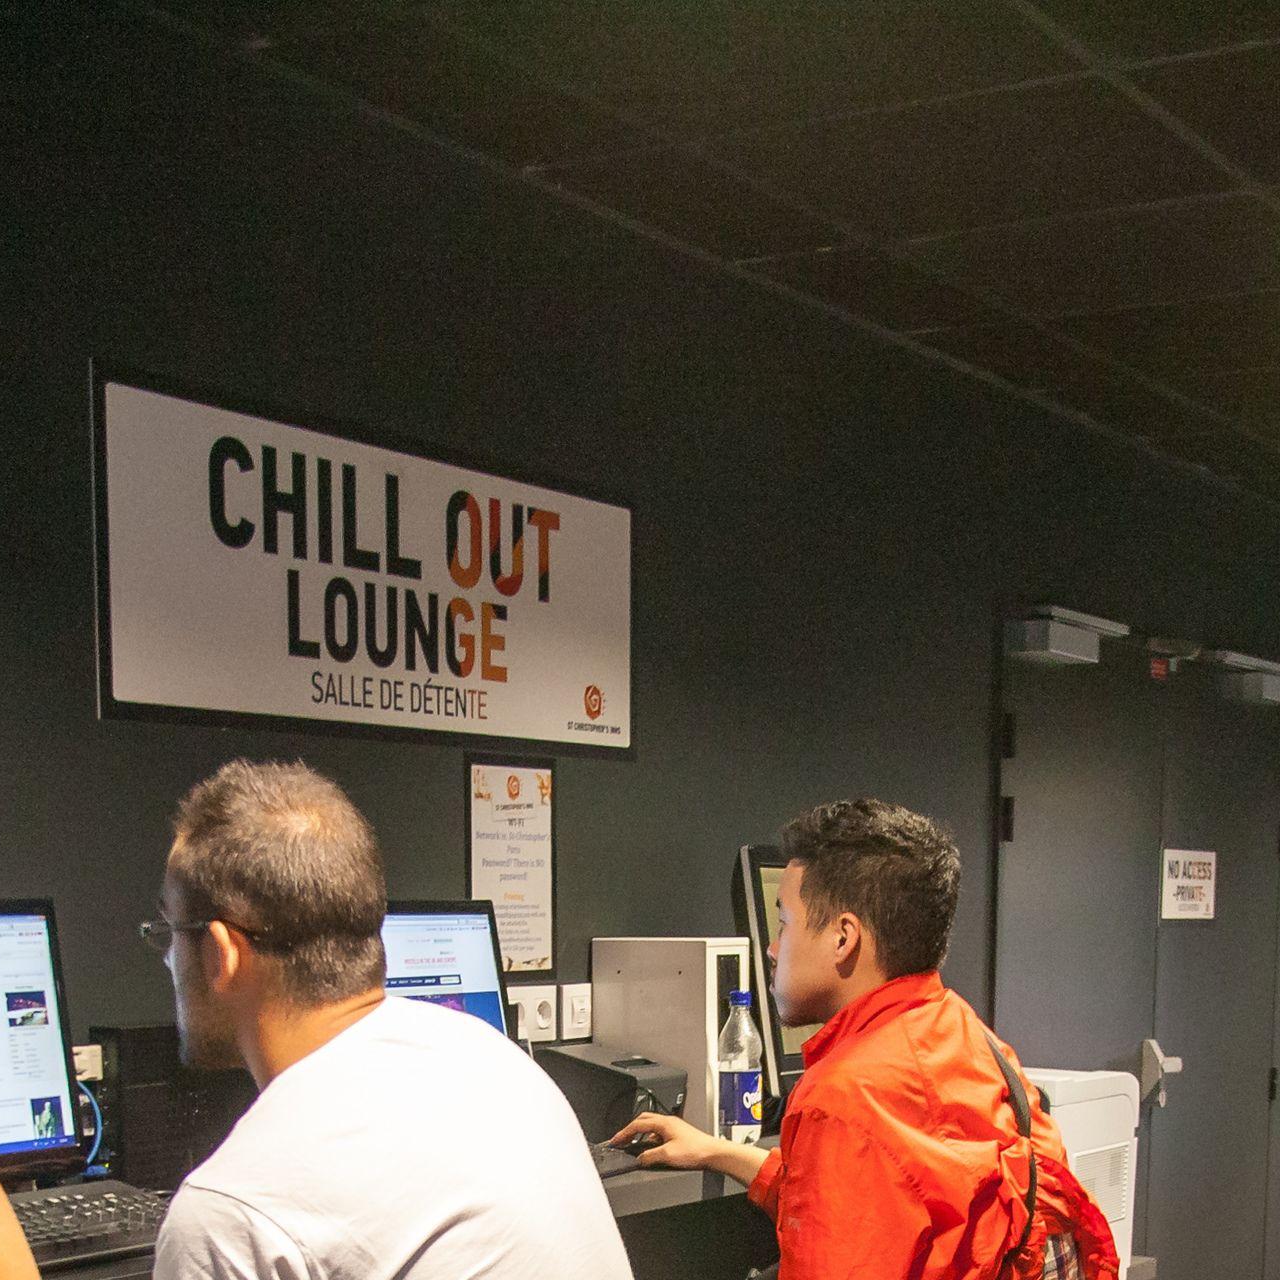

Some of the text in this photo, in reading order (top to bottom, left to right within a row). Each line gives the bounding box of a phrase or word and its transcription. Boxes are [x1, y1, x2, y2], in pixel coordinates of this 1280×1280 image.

[208, 436, 560, 603] CHILL OUT
[287, 569, 508, 683] LOUNGE
[311, 671, 488, 720] SALLE DE DÉTENTE
[1167, 860, 1211, 881] NO ACCESS
